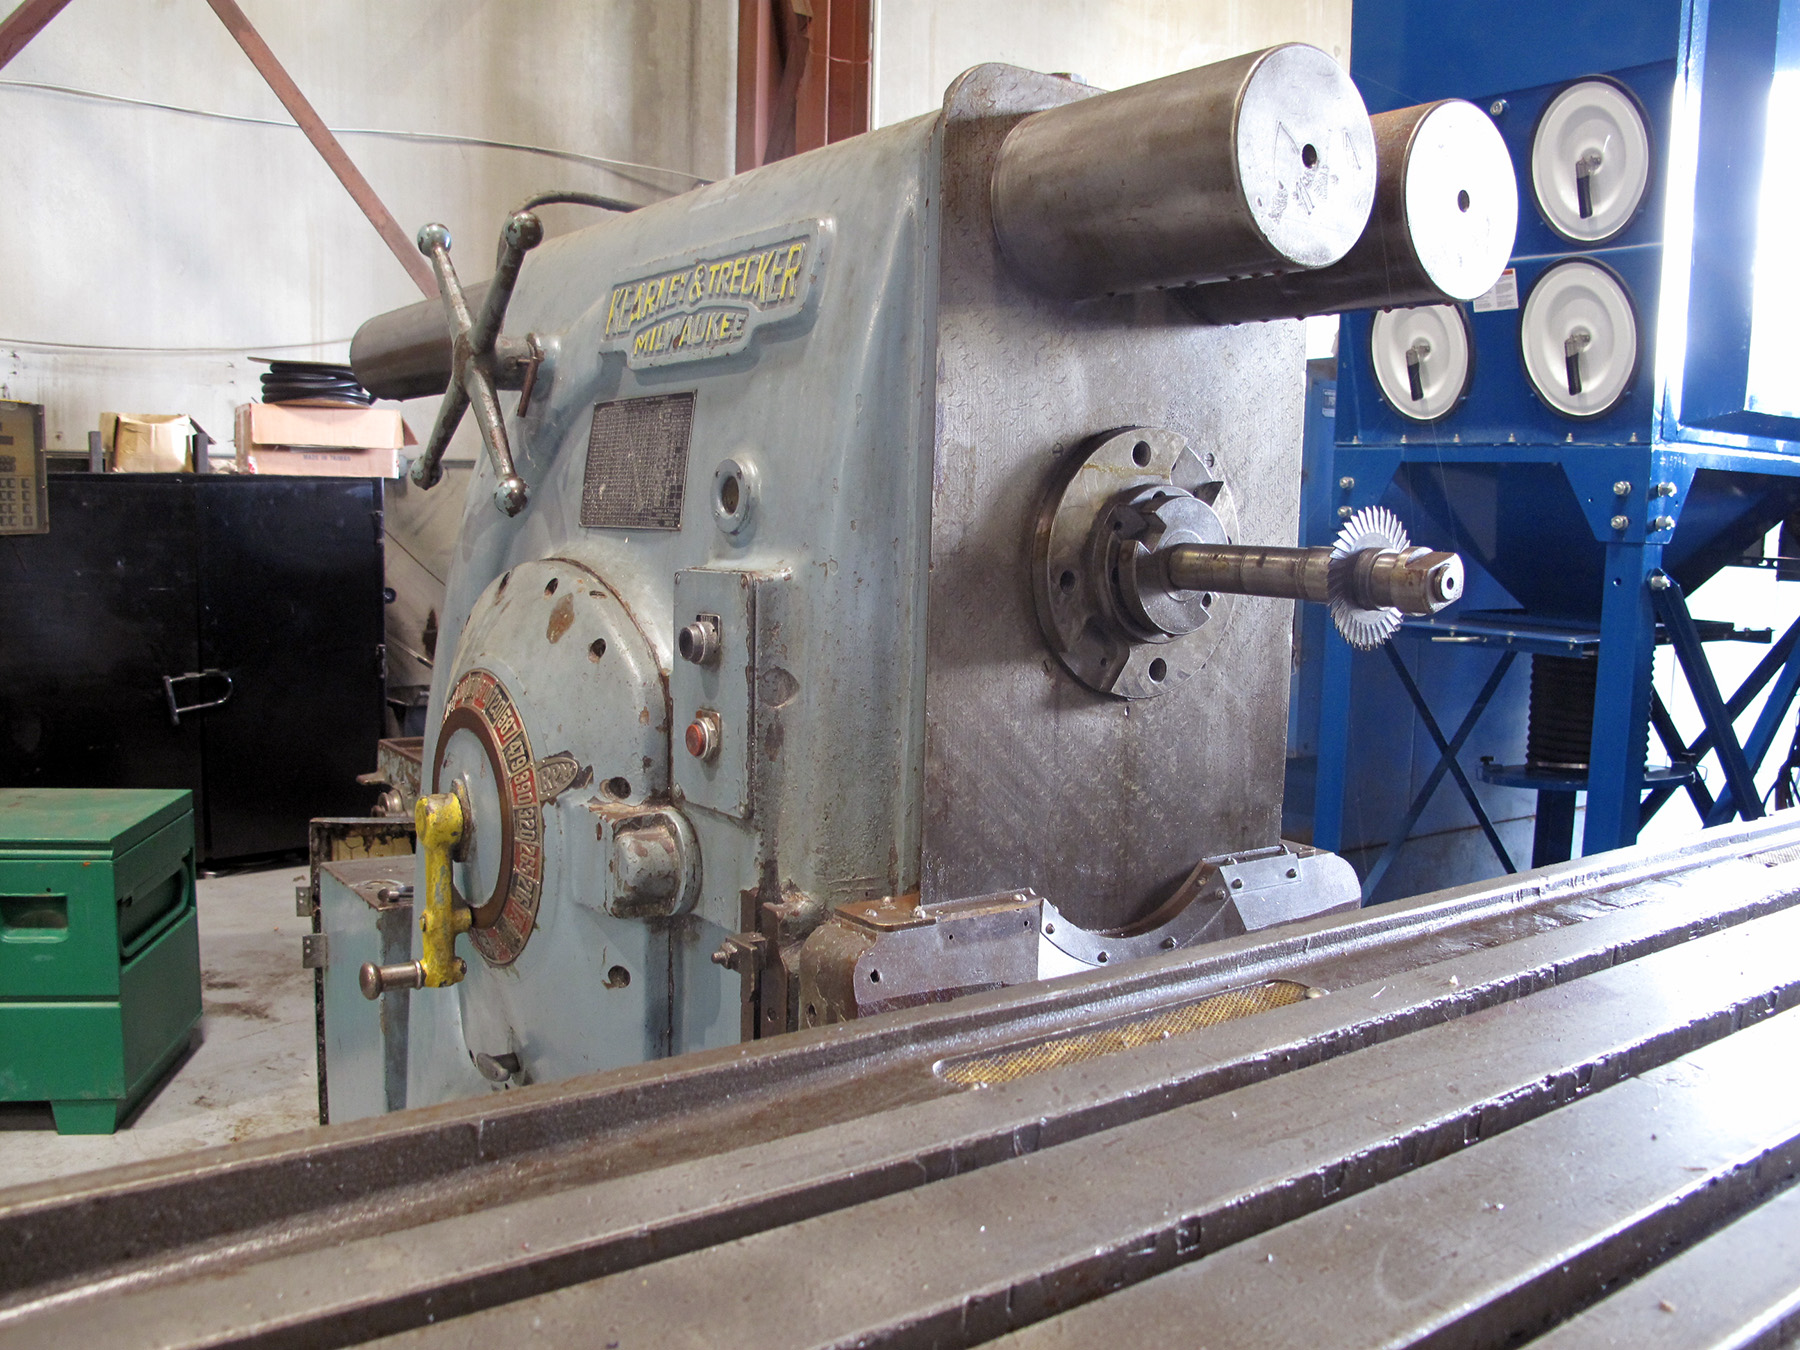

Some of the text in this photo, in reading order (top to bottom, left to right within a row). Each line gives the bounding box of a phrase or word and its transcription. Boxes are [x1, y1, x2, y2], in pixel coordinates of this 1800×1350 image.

[605, 243, 806, 336] KEARNEY & TRECKER
[634, 312, 747, 355] MILWAUKEE
[486, 687, 506, 720] 720
[497, 708, 518, 741] 587
[506, 740, 527, 772] 479
[514, 770, 533, 805] 390
[541, 761, 576, 792] RPM
[518, 808, 536, 840] 320
[519, 843, 536, 879] 265
[515, 876, 533, 909] 216
